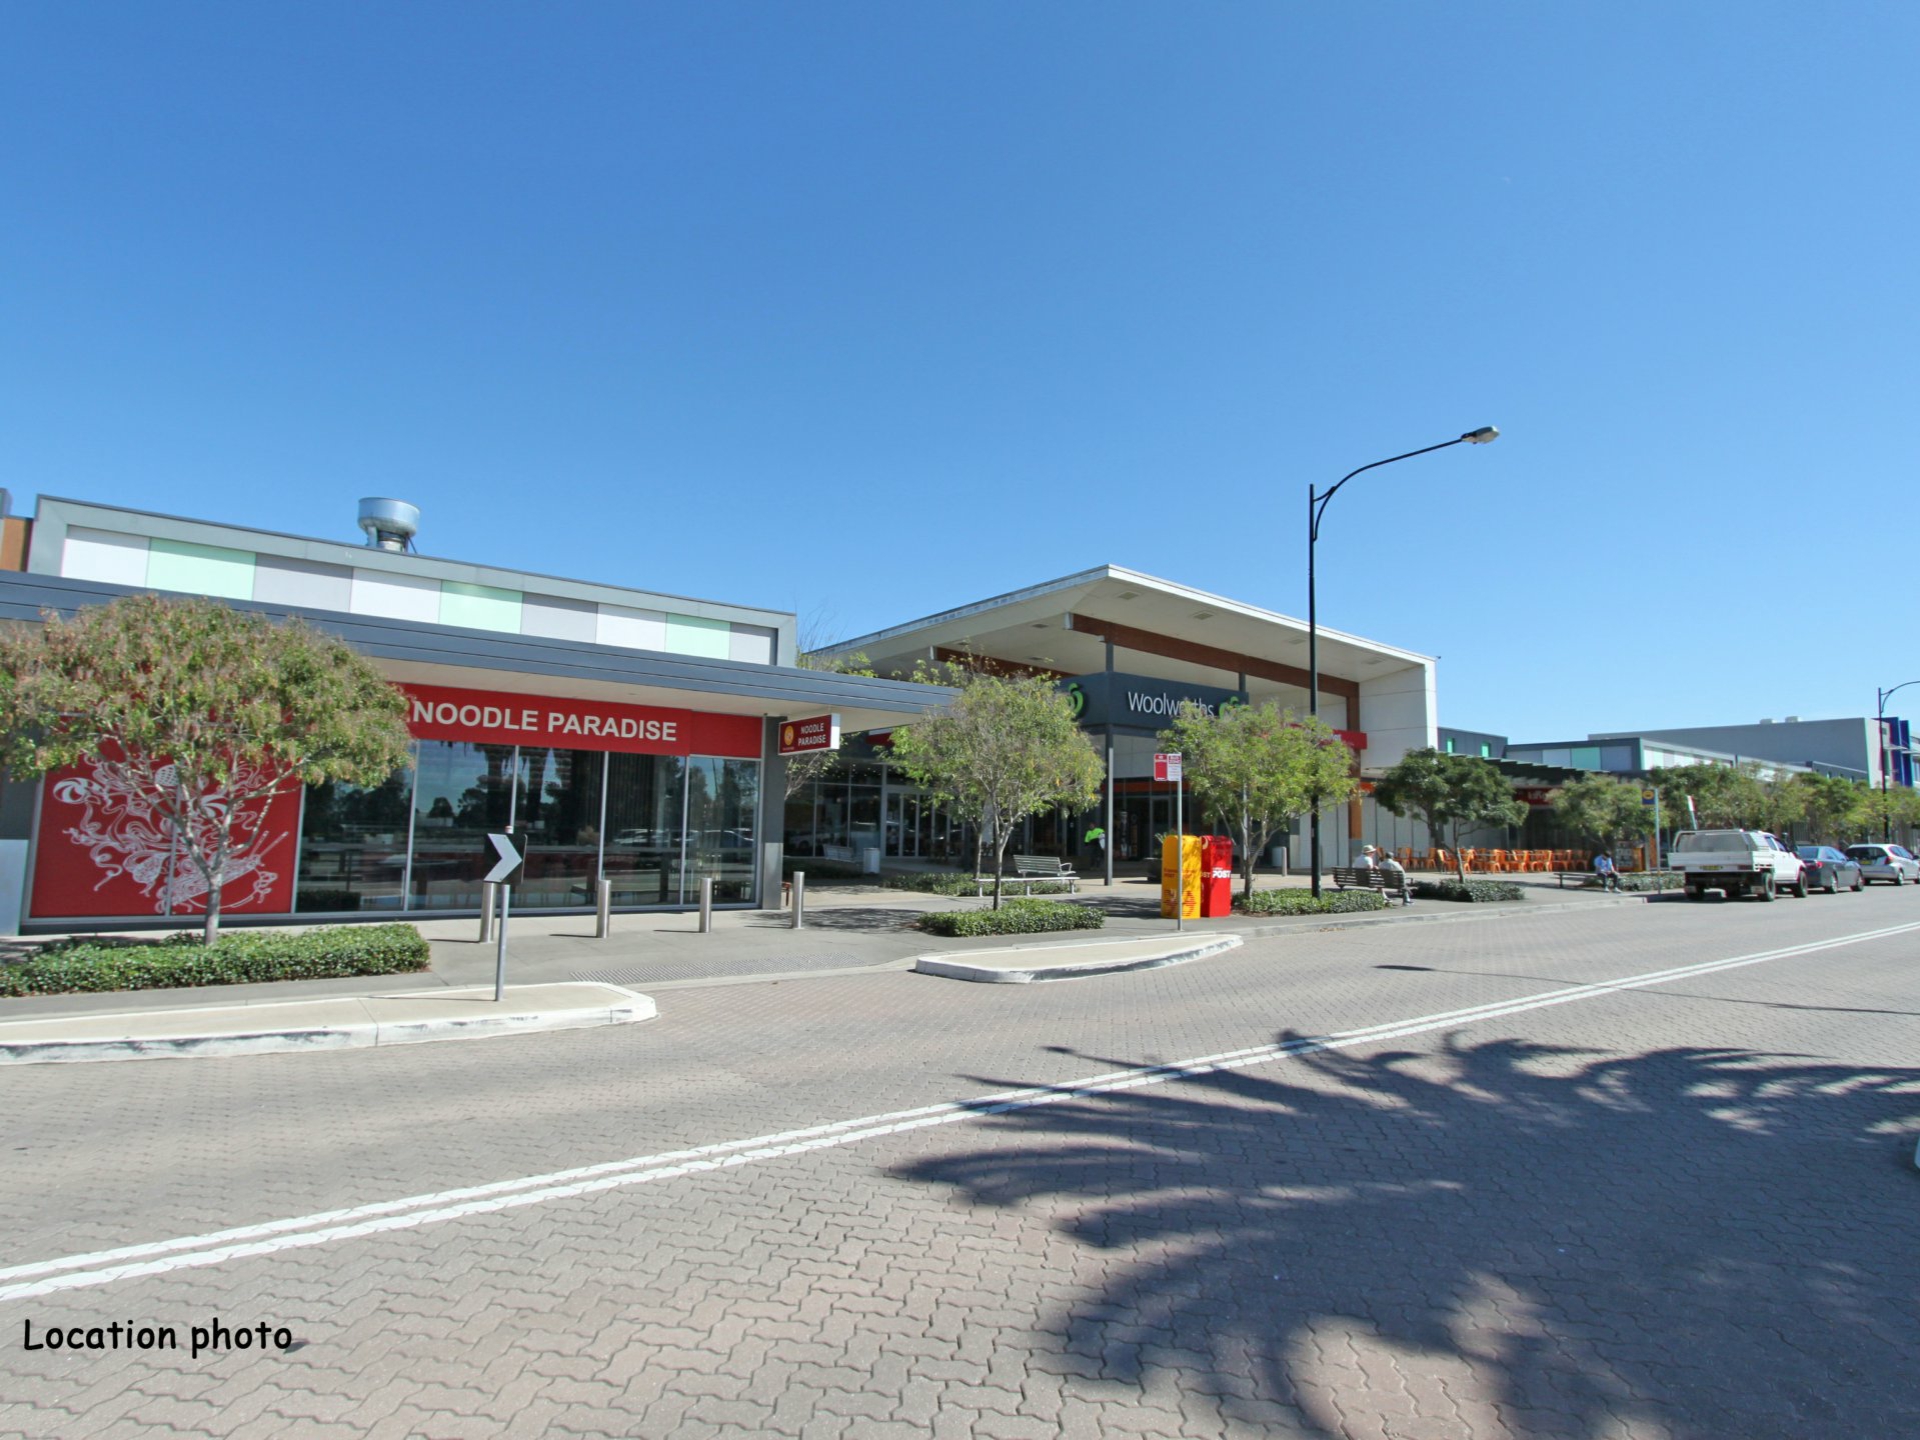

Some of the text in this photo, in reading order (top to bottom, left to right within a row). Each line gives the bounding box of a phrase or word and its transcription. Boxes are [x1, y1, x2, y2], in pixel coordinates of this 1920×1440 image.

[1127, 691, 1215, 717] Woolwths
[412, 700, 678, 742] NOODLE PARADISE
[800, 722, 825, 734] NOODLE
[797, 734, 827, 747] PARADISE
[1212, 870, 1231, 879] POST
